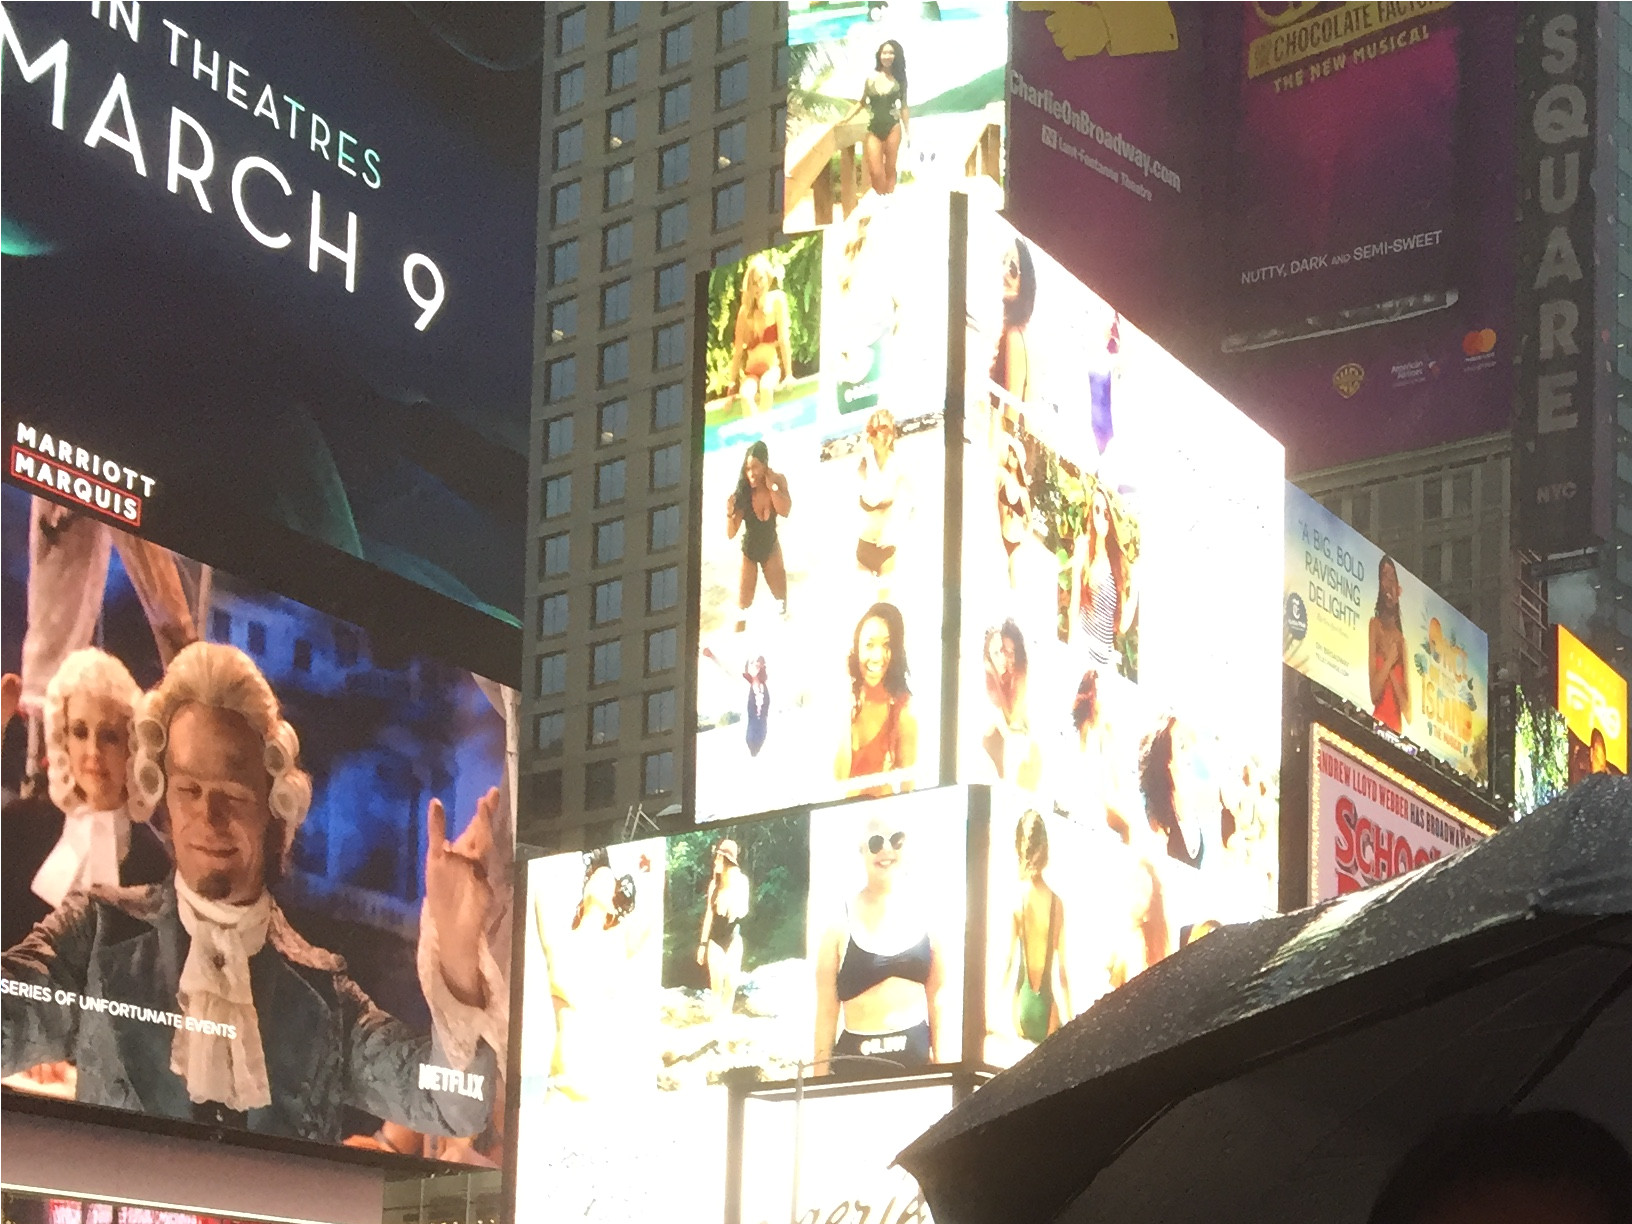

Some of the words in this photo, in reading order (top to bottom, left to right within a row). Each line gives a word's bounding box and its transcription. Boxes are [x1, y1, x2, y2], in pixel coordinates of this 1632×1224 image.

[1273, 68, 1304, 93] THE
[1310, 53, 1347, 82] NEW
[1353, 25, 1430, 64] MUSICAL
[1274, 3, 1373, 62] CHOCOLATE
[163, 19, 381, 189] THEATRES
[1010, 69, 1181, 193] CharlieOnBroadway.com
[0, 5, 357, 293] MARCH
[403, 252, 446, 332] 9
[1532, 13, 1589, 435] SQUARE
[1241, 264, 1288, 285] NUTTY,
[1291, 253, 1328, 275] DARK
[1331, 253, 1351, 266] AND
[1353, 230, 1443, 261] SEMI-SWEET
[15, 452, 138, 520] MARQUIS
[16, 421, 156, 498] MARRIOTT
[1535, 481, 1578, 503] NYC
[1305, 551, 1361, 607] RAVISHING
[1337, 545, 1365, 582] BOLD
[1352, 769, 1378, 803] LLOYD
[1410, 802, 1425, 830] HAS
[1334, 795, 1442, 882] SCHO
[0, 978, 52, 1003] SERIES
[54, 989, 77, 1007] OF
[79, 995, 184, 1030] UNFORTUNATE
[185, 1016, 238, 1041] EVENTS
[418, 1062, 485, 1102] NETFLIX
